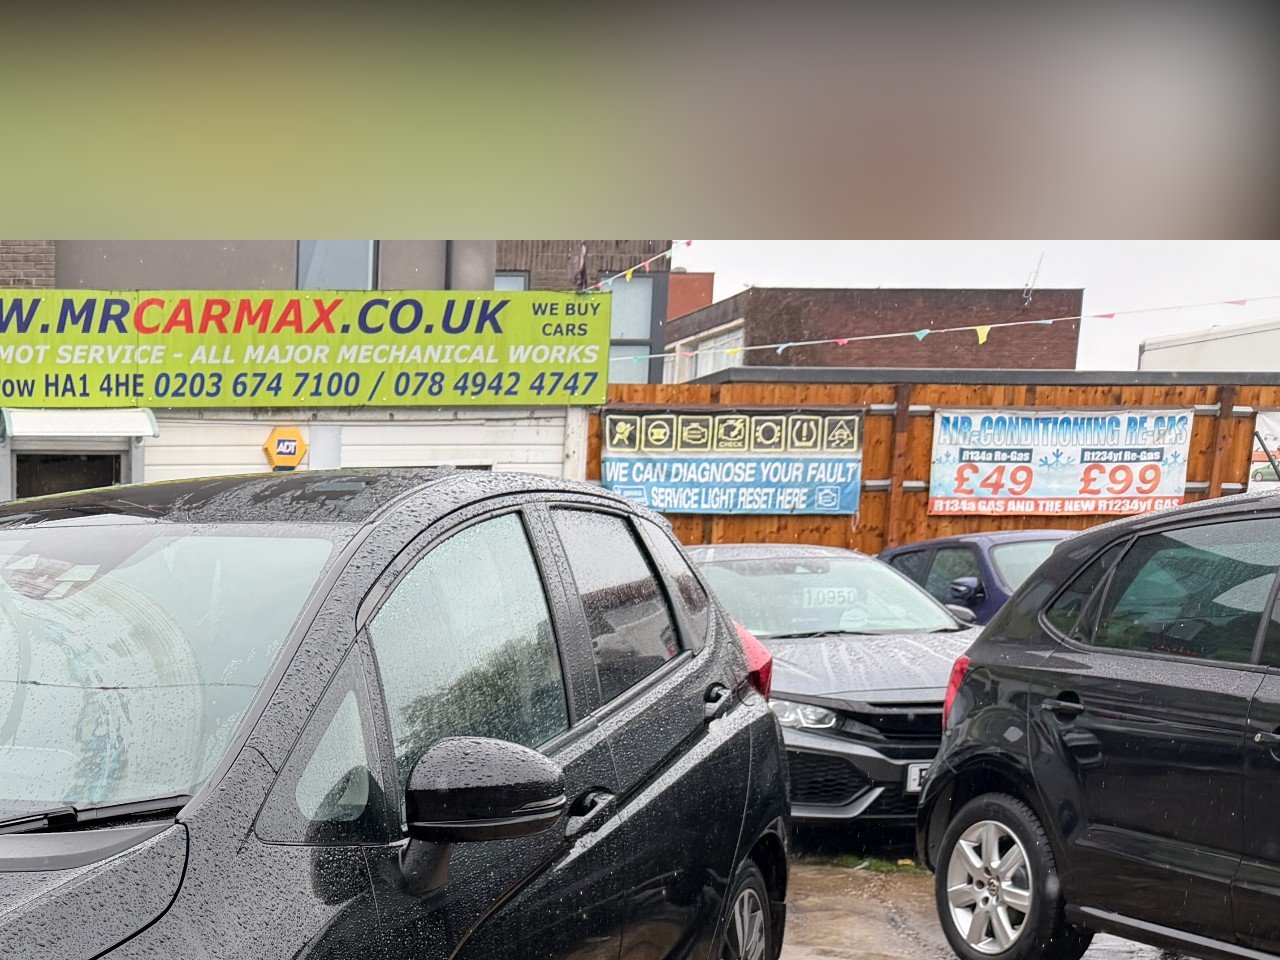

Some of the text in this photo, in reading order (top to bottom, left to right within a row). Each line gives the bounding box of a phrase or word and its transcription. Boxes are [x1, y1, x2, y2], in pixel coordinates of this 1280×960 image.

[532, 302, 601, 317] WE BUY
[542, 322, 588, 337] CARS
[56, 344, 166, 365] SERVICE
[190, 344, 235, 365] ALL
[243, 344, 329, 365] MAJOR
[336, 344, 498, 365] MECHANICAL
[508, 344, 599, 365] WORKS
[45, 373, 89, 398] HA1
[99, 373, 144, 398] 4HE
[154, 372, 222, 398] 0203
[232, 372, 282, 398] 674
[293, 372, 360, 398] 7100
[368, 370, 386, 401] /
[394, 372, 445, 397] 078
[453, 372, 519, 397] 4942
[529, 372, 598, 397] 4747
[938, 416, 1121, 446] AIR-CONDITIONING
[276, 440, 297, 454] ADT
[1124, 451, 1161, 461] Re-Gas
[605, 461, 629, 482] WE
[632, 461, 668, 482] CAN
[670, 461, 757, 483] DIAGNOSE
[761, 461, 804, 483] YOUR
[953, 463, 1034, 496] £49
[1078, 463, 1162, 495] £99
[651, 486, 809, 509] SERVICE LIGHT RESET HERE
[977, 500, 1005, 512] GAS
[1007, 500, 1035, 512] AND
[1038, 500, 1062, 512] THE
[1064, 500, 1096, 512] NEW
[1154, 498, 1180, 509] GAS
